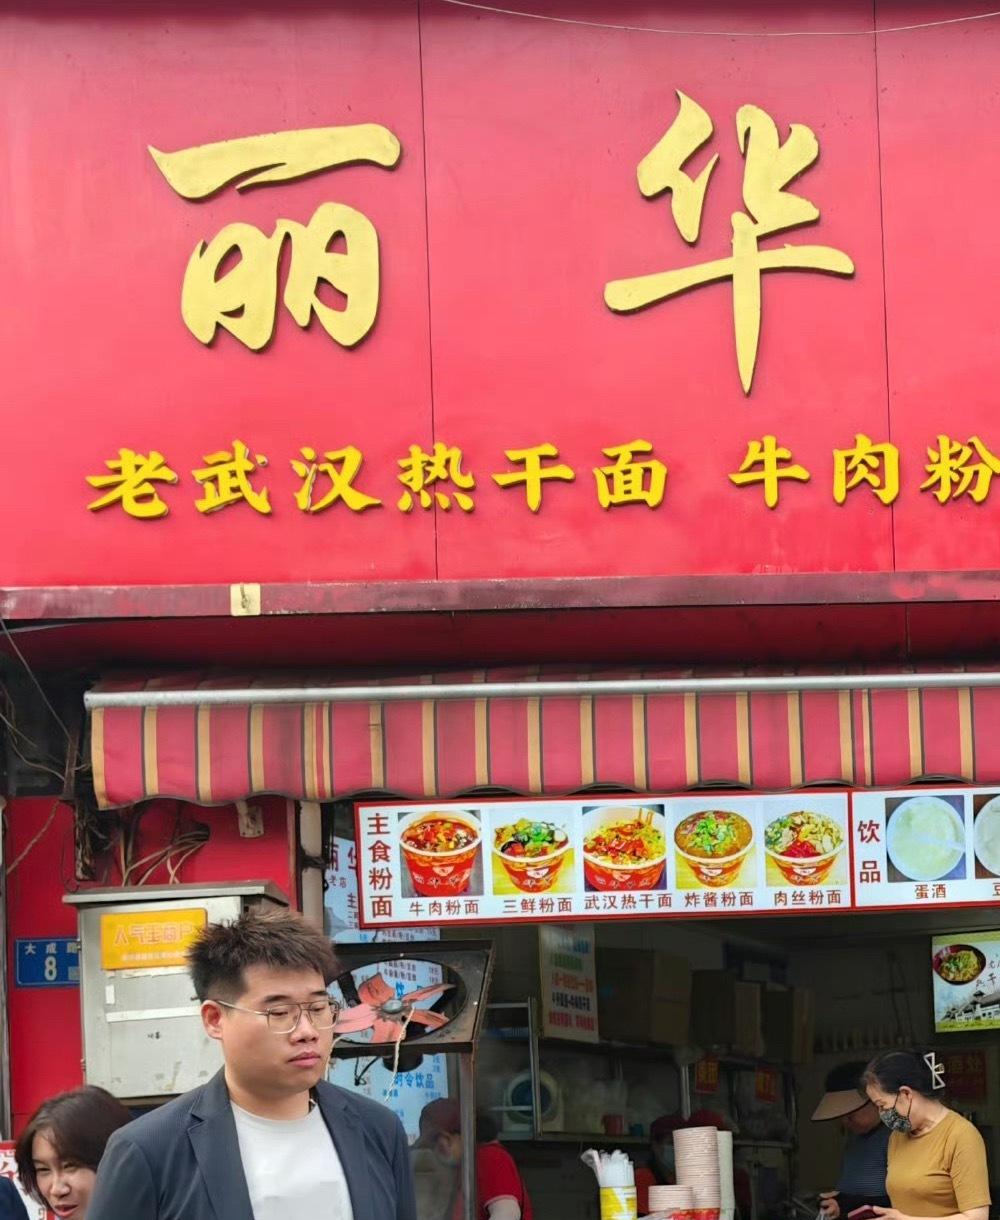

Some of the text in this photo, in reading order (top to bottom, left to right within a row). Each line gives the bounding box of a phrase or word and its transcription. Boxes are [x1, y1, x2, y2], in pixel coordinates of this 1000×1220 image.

[86, 439, 669, 518] 老武汉热干面
[858, 820, 881, 884] 饮品
[367, 812, 393, 918] 主食粉面
[684, 891, 754, 908] 炸酱粉面
[773, 889, 842, 907] 肉丝粉面
[914, 884, 947, 899] 蛋酒
[408, 898, 480, 916] 牛肉粉面
[502, 896, 573, 914] 三鲜粉面
[584, 893, 673, 911] 武汉热干面
[44, 956, 57, 981] 8
